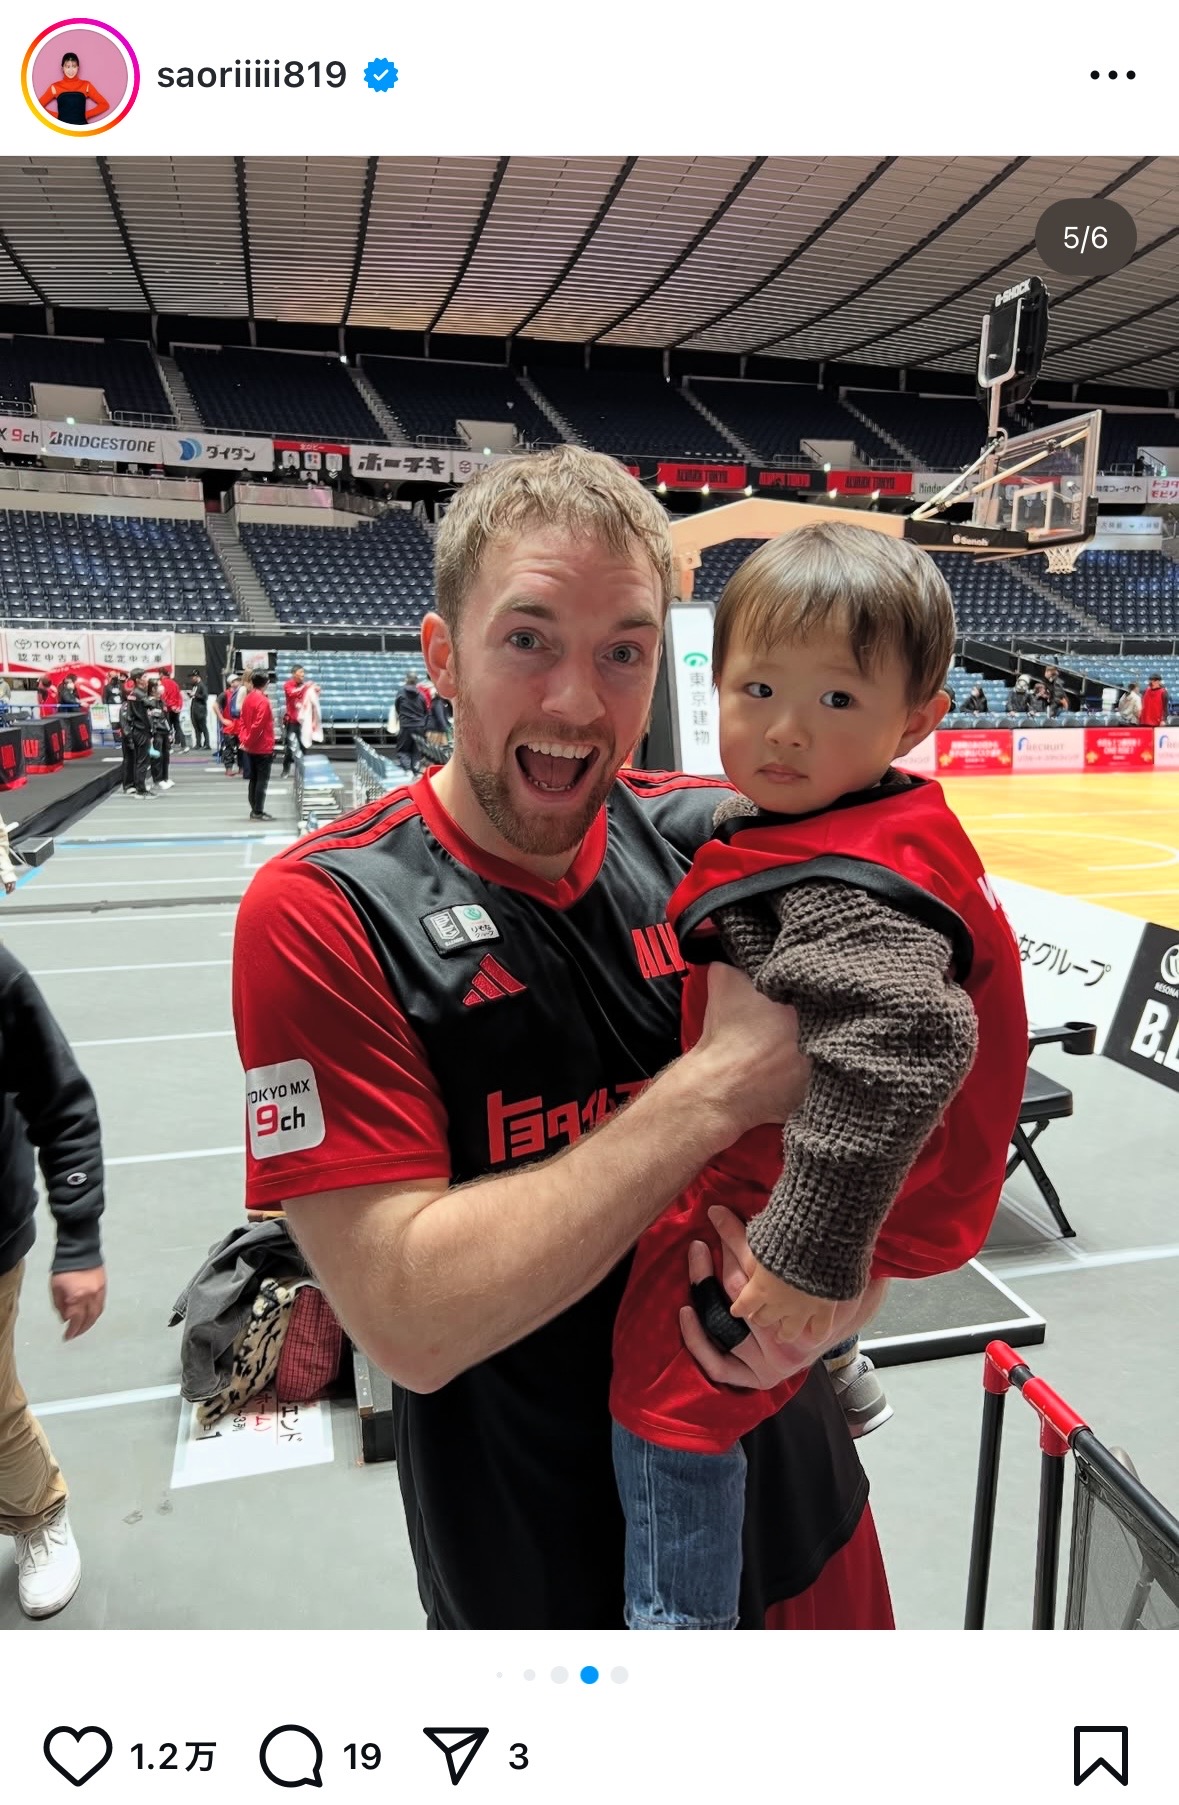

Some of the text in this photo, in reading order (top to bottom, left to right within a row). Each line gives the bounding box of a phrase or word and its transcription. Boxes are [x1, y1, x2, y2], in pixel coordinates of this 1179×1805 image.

[11, 428, 39, 444] 9ch
[49, 431, 156, 453] BRIDGESTONE
[206, 444, 256, 462] ダイダン
[358, 452, 445, 475] ホーチキ
[34, 640, 81, 650] TOYOTA
[119, 641, 163, 651] TOYOTA
[290, 1078, 310, 1095] MX
[256, 1103, 306, 1137] 9ch
